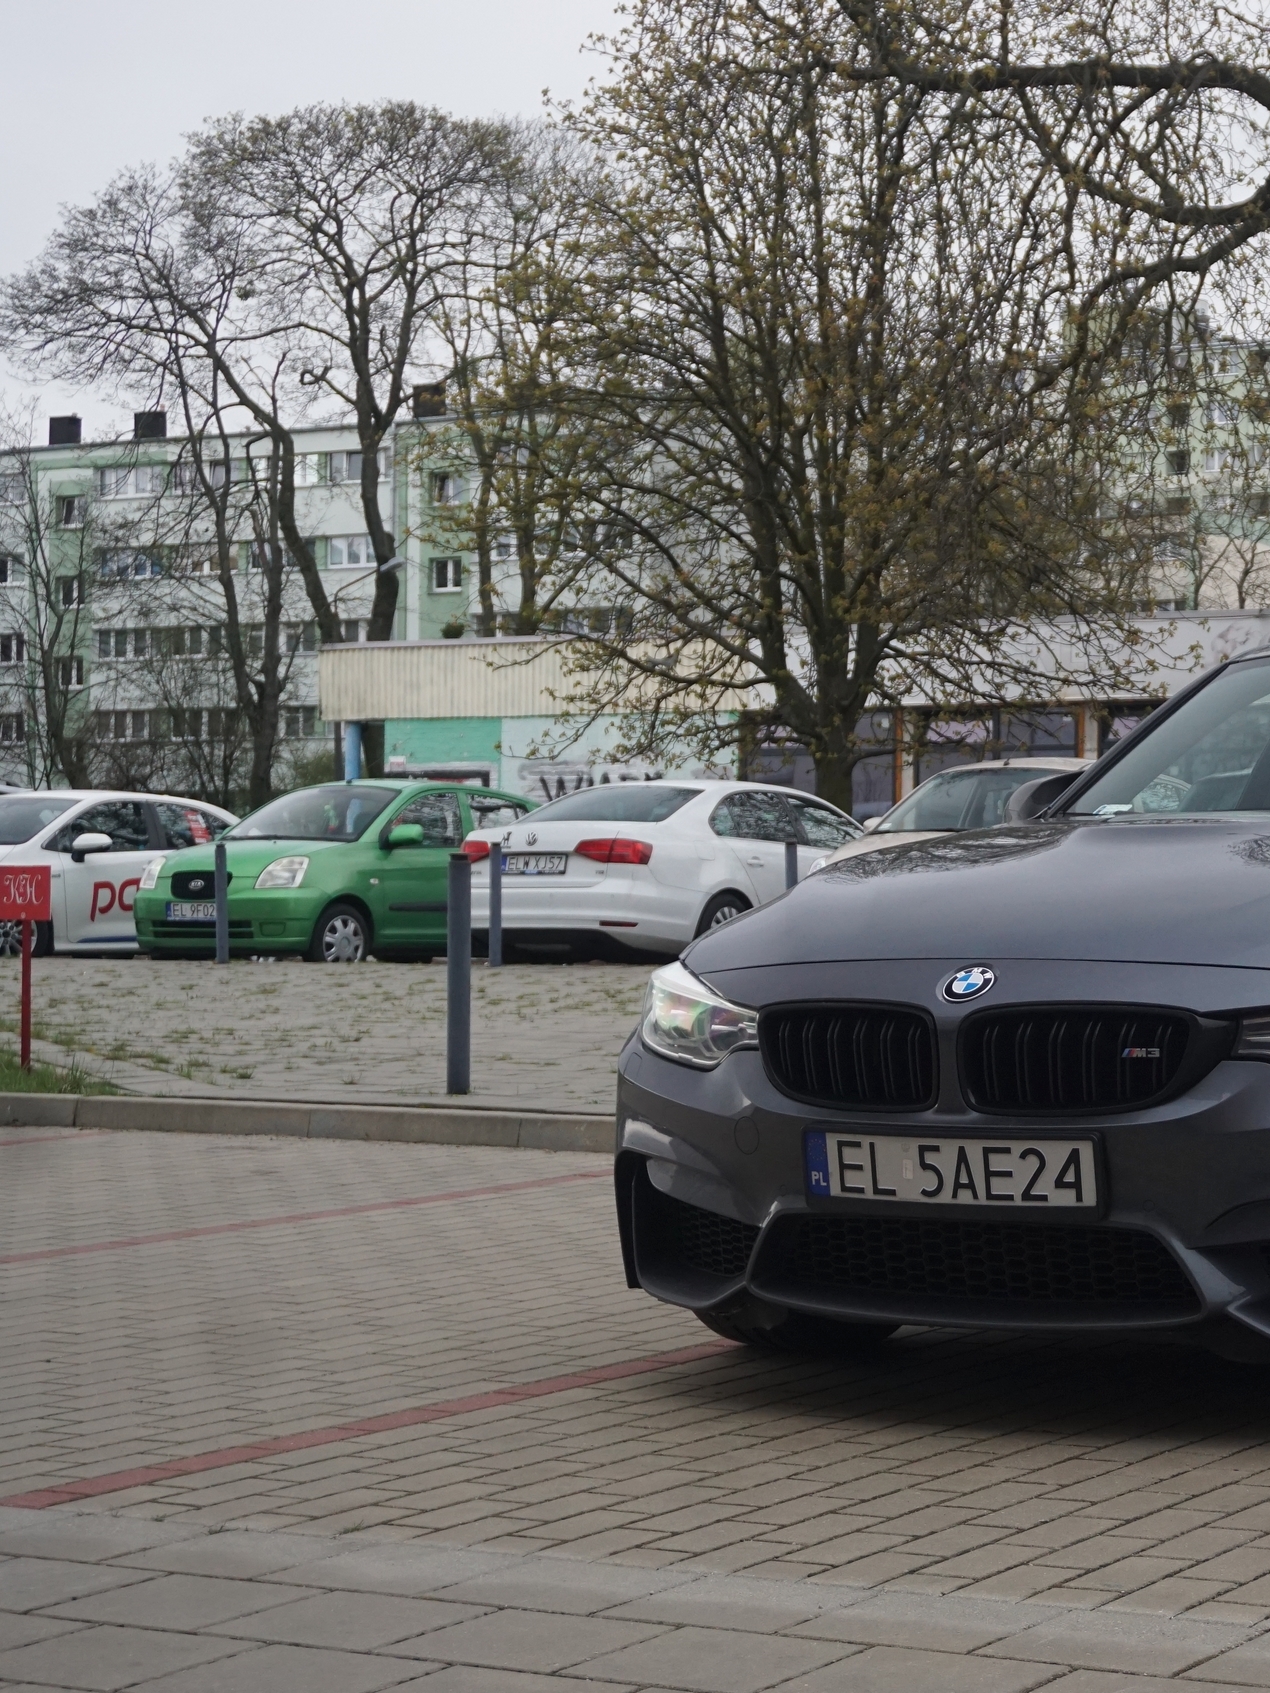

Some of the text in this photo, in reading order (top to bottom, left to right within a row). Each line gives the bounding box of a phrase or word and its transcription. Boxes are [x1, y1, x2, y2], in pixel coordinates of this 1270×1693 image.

[507, 856, 531, 870] ELW
[172, 904, 216, 917] EL 9F02
[811, 1171, 828, 1187] PL
[836, 1139, 1084, 1204] EL 5AE24
